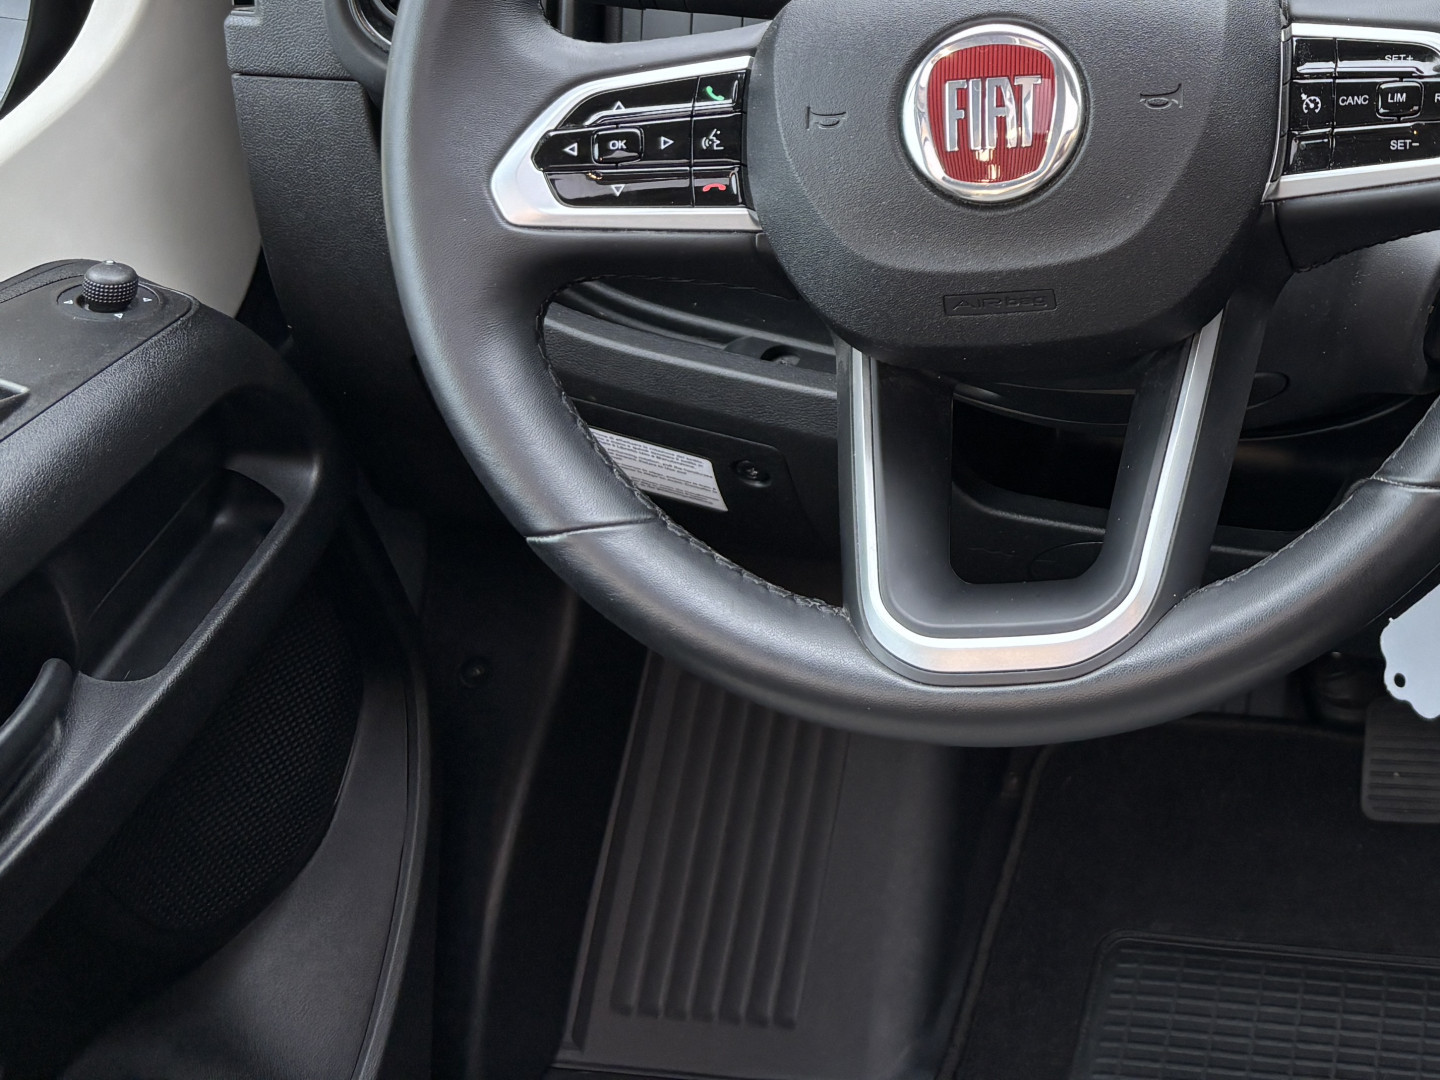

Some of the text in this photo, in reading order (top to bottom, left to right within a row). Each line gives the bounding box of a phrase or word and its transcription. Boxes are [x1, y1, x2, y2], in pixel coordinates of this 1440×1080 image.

[1339, 94, 1369, 106] CANC
[1387, 92, 1407, 103] LIM
[945, 75, 1042, 153] FIAT
[609, 139, 627, 150] OK
